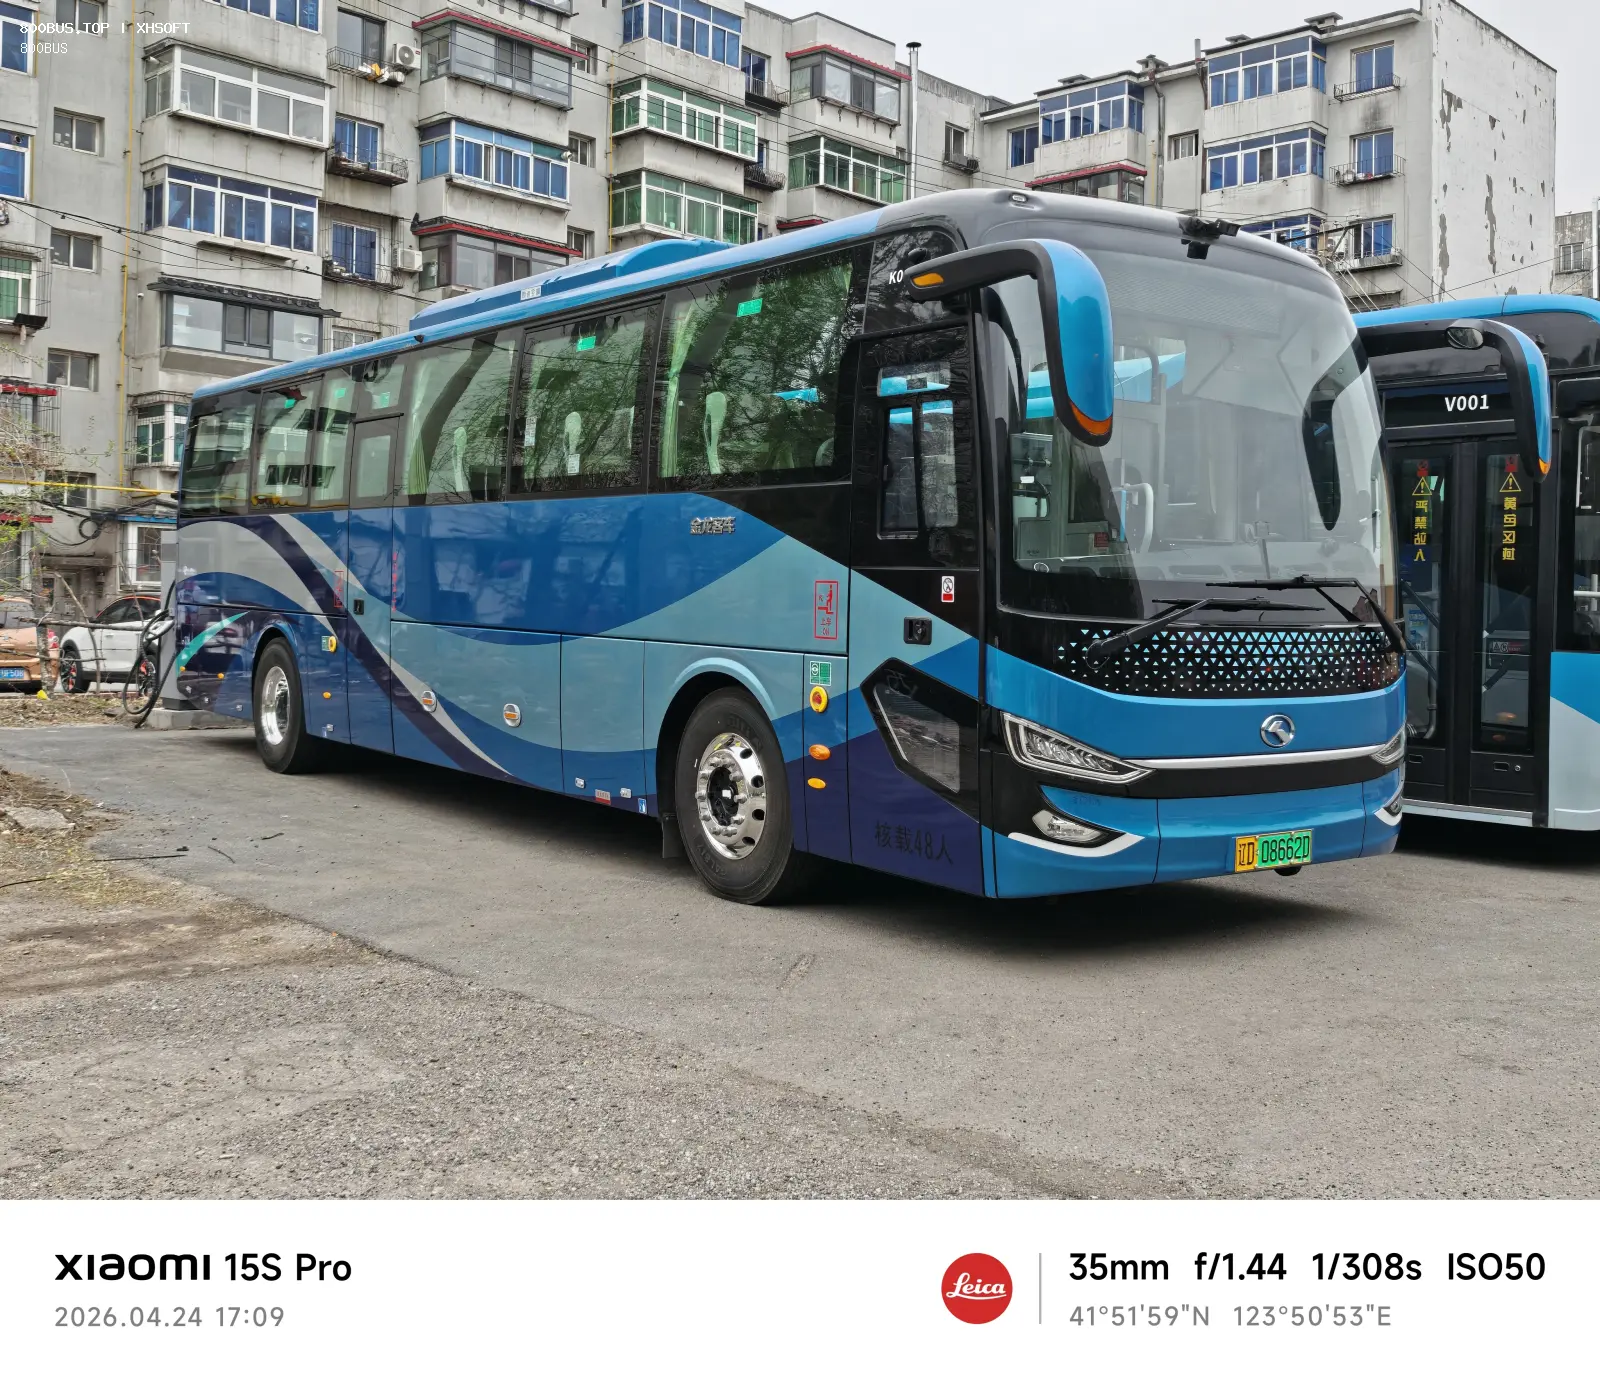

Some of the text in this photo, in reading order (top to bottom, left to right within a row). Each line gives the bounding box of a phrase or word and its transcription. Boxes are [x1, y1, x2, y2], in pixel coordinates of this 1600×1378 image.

[1444, 394, 1490, 412] V001
[875, 820, 954, 866] 核载48人
[1261, 835, 1310, 863] 08662D
